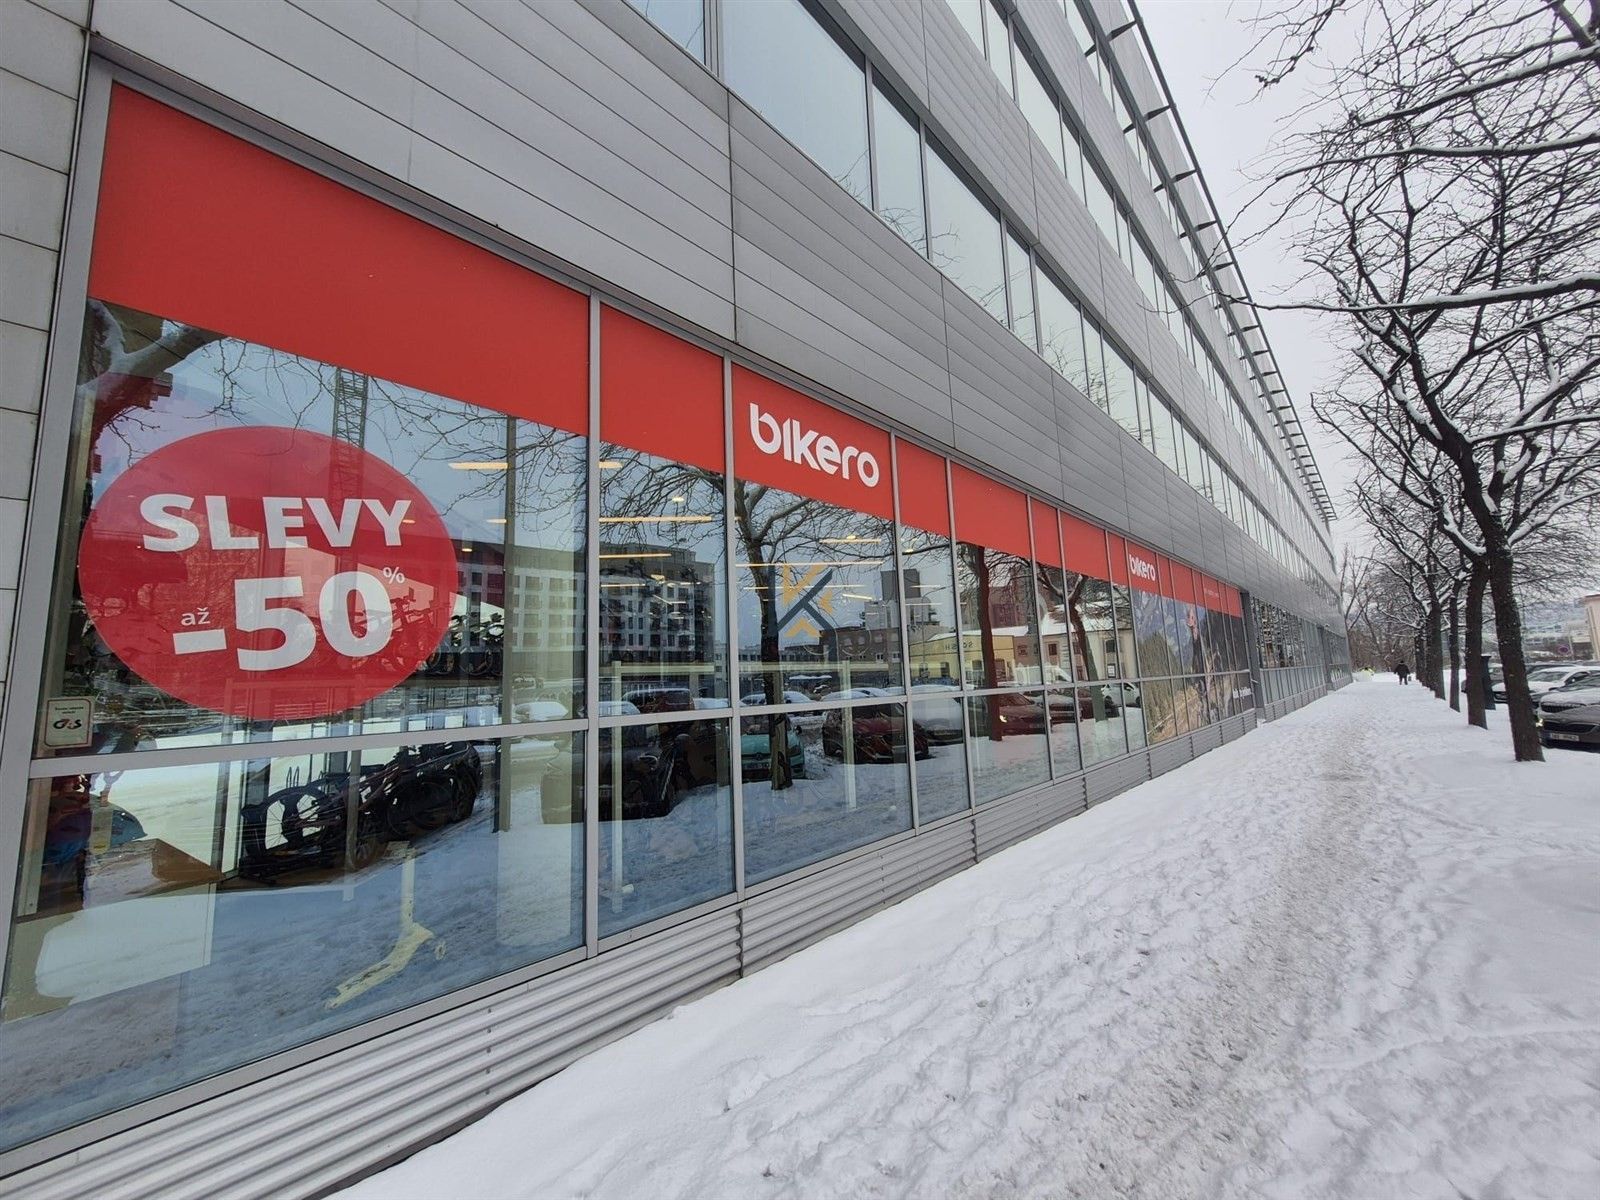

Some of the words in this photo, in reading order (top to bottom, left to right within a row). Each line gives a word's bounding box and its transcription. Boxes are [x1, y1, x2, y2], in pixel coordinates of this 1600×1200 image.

[749, 402, 880, 488] bikero
[140, 493, 412, 553] SLEVY
[1128, 554, 1156, 582] bikero
[181, 606, 211, 627] až
